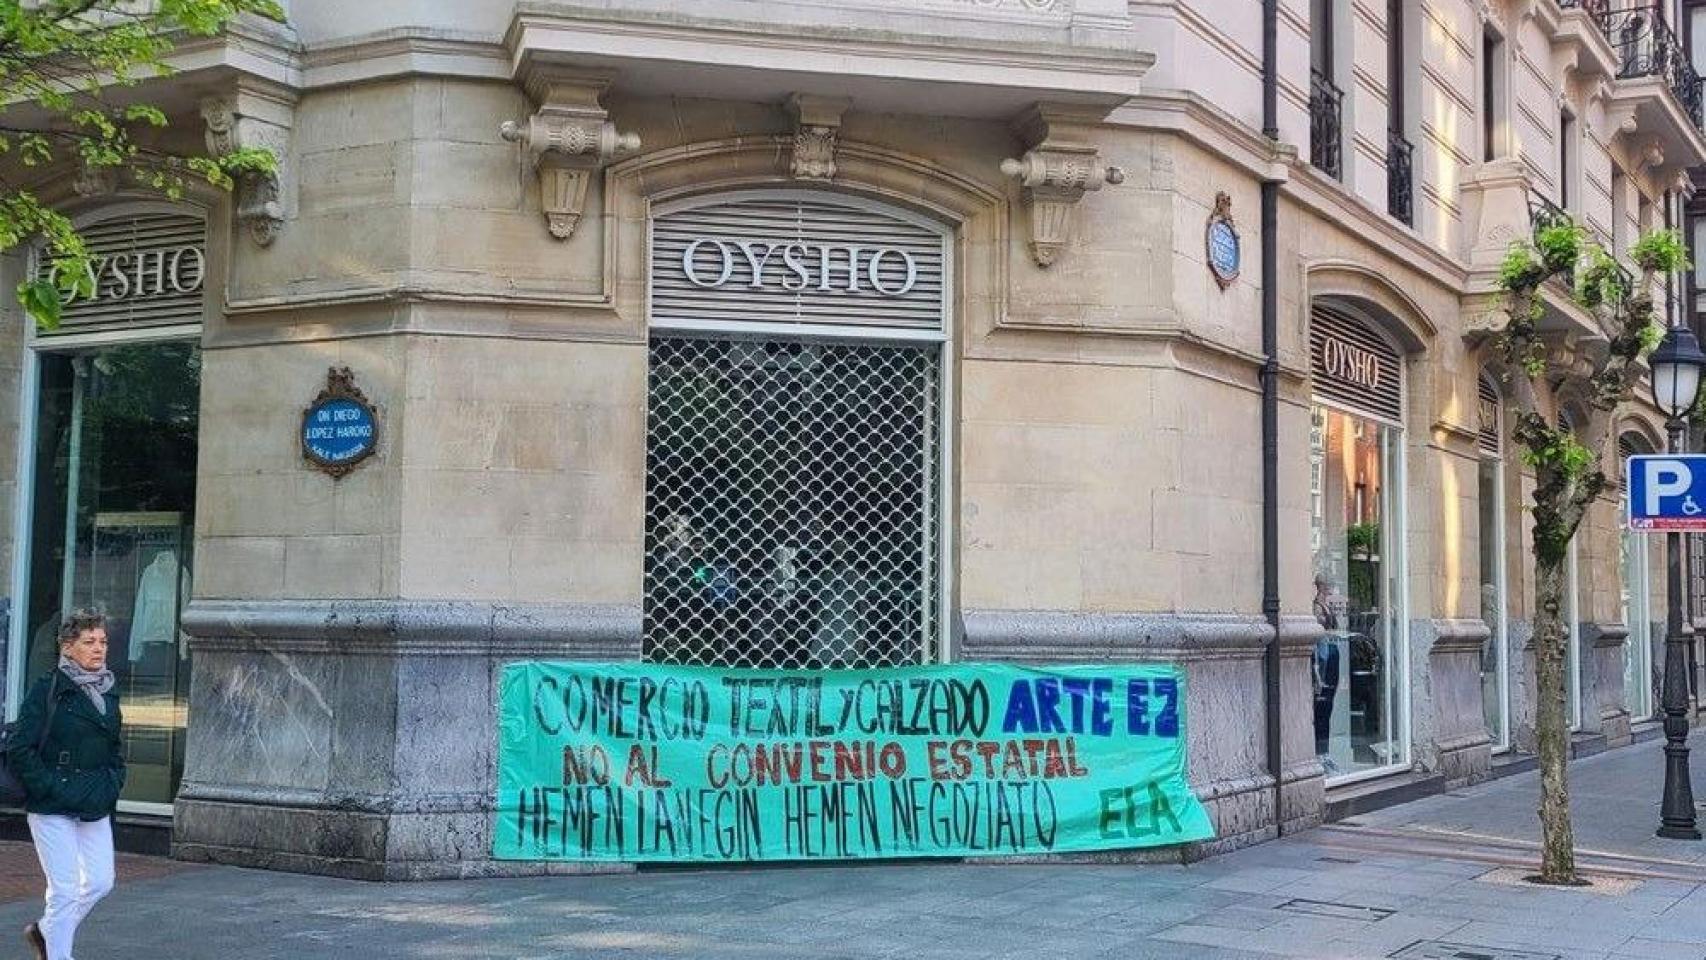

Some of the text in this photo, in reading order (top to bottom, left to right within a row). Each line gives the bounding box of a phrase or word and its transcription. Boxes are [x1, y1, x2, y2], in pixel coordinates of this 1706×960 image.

[683, 238, 917, 296] OYSHO
[1325, 338, 1378, 388] OYSHO
[305, 426, 335, 439] LOPEZ
[334, 408, 361, 421] DIEGO
[1645, 460, 1693, 516] P
[534, 674, 711, 741] COMERCIO
[722, 676, 835, 739] TEXTIL
[856, 678, 990, 738] CALZADO
[1002, 677, 1114, 738] ARTE
[1127, 677, 1180, 738] EZ
[562, 736, 1089, 789] NO AL CONVENIO ESTATAL
[518, 785, 626, 857] HEMEN
[784, 781, 882, 857] HEMEN
[890, 777, 1058, 852] NEGOZIATO
[1099, 780, 1184, 841] ELA
